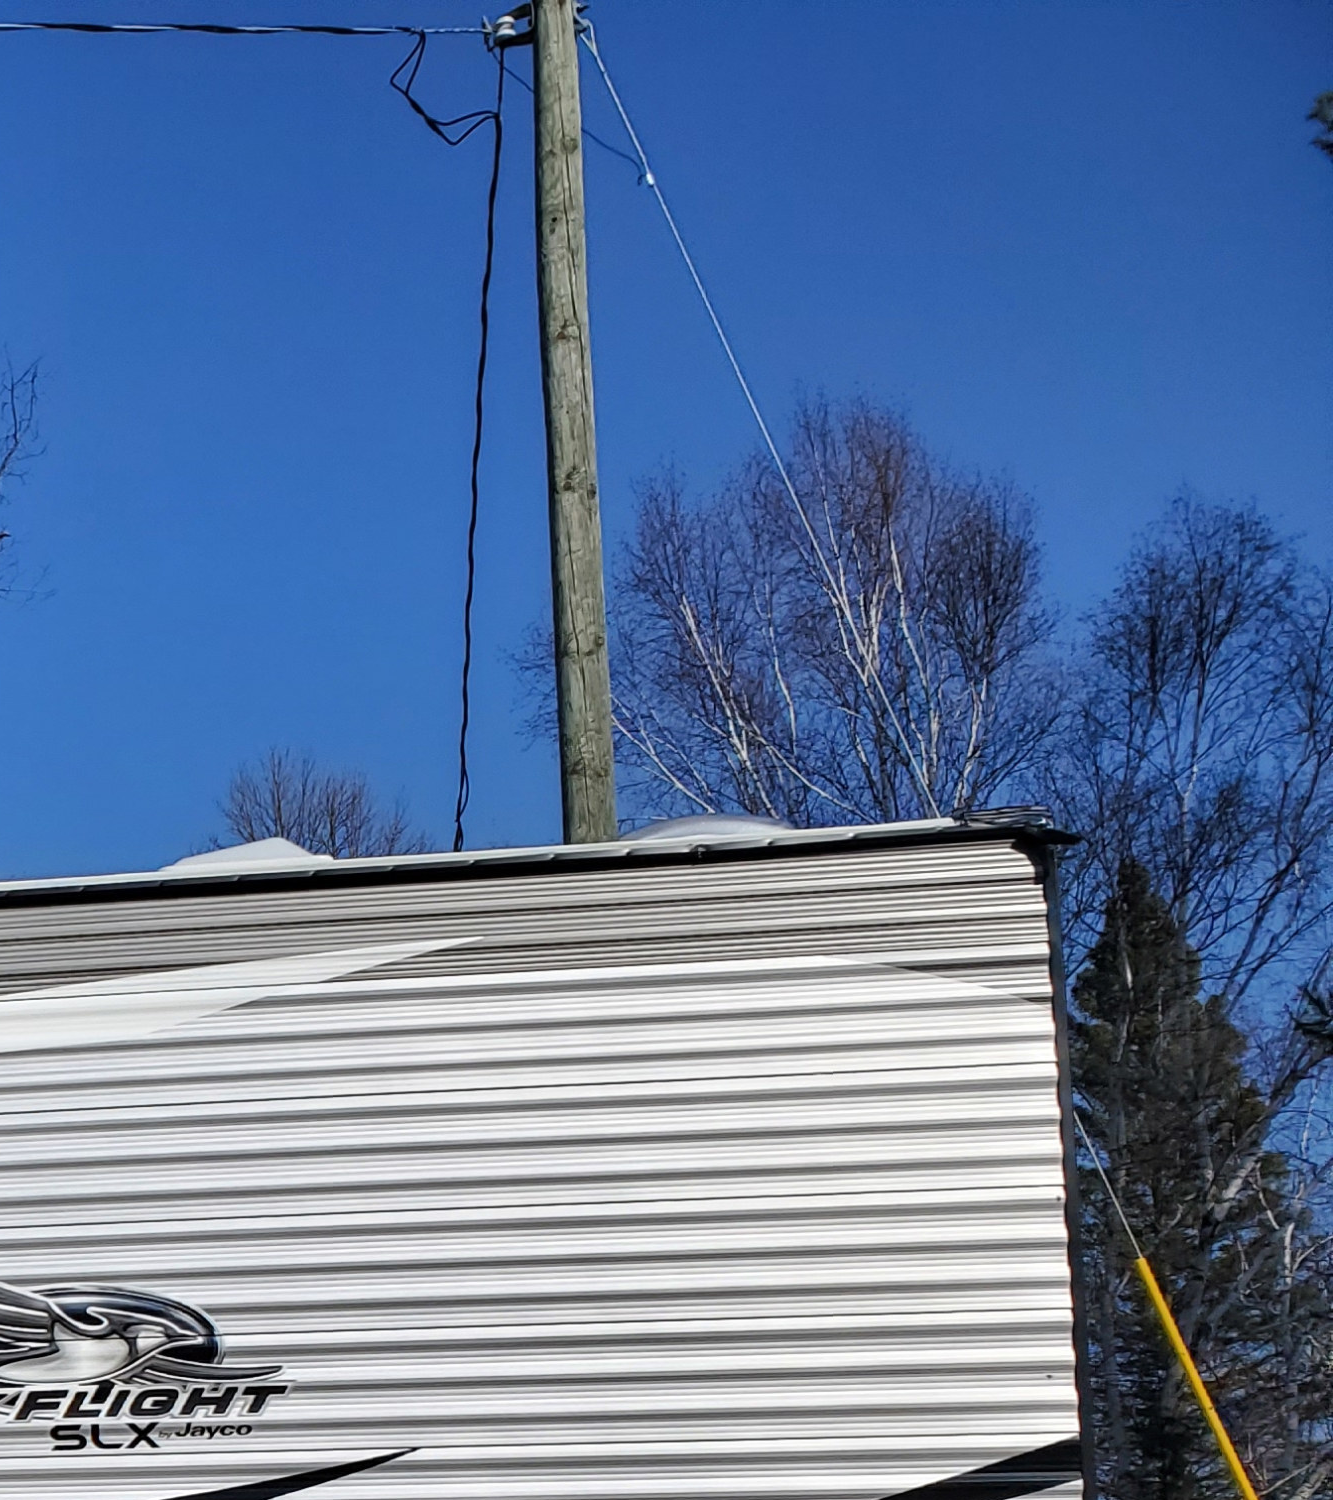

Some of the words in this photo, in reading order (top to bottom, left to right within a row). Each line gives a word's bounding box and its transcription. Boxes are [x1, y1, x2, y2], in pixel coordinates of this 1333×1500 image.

[13, 1384, 290, 1421] FLIGHT
[49, 1421, 161, 1451] SLX
[174, 1421, 253, 1440] Jayco
